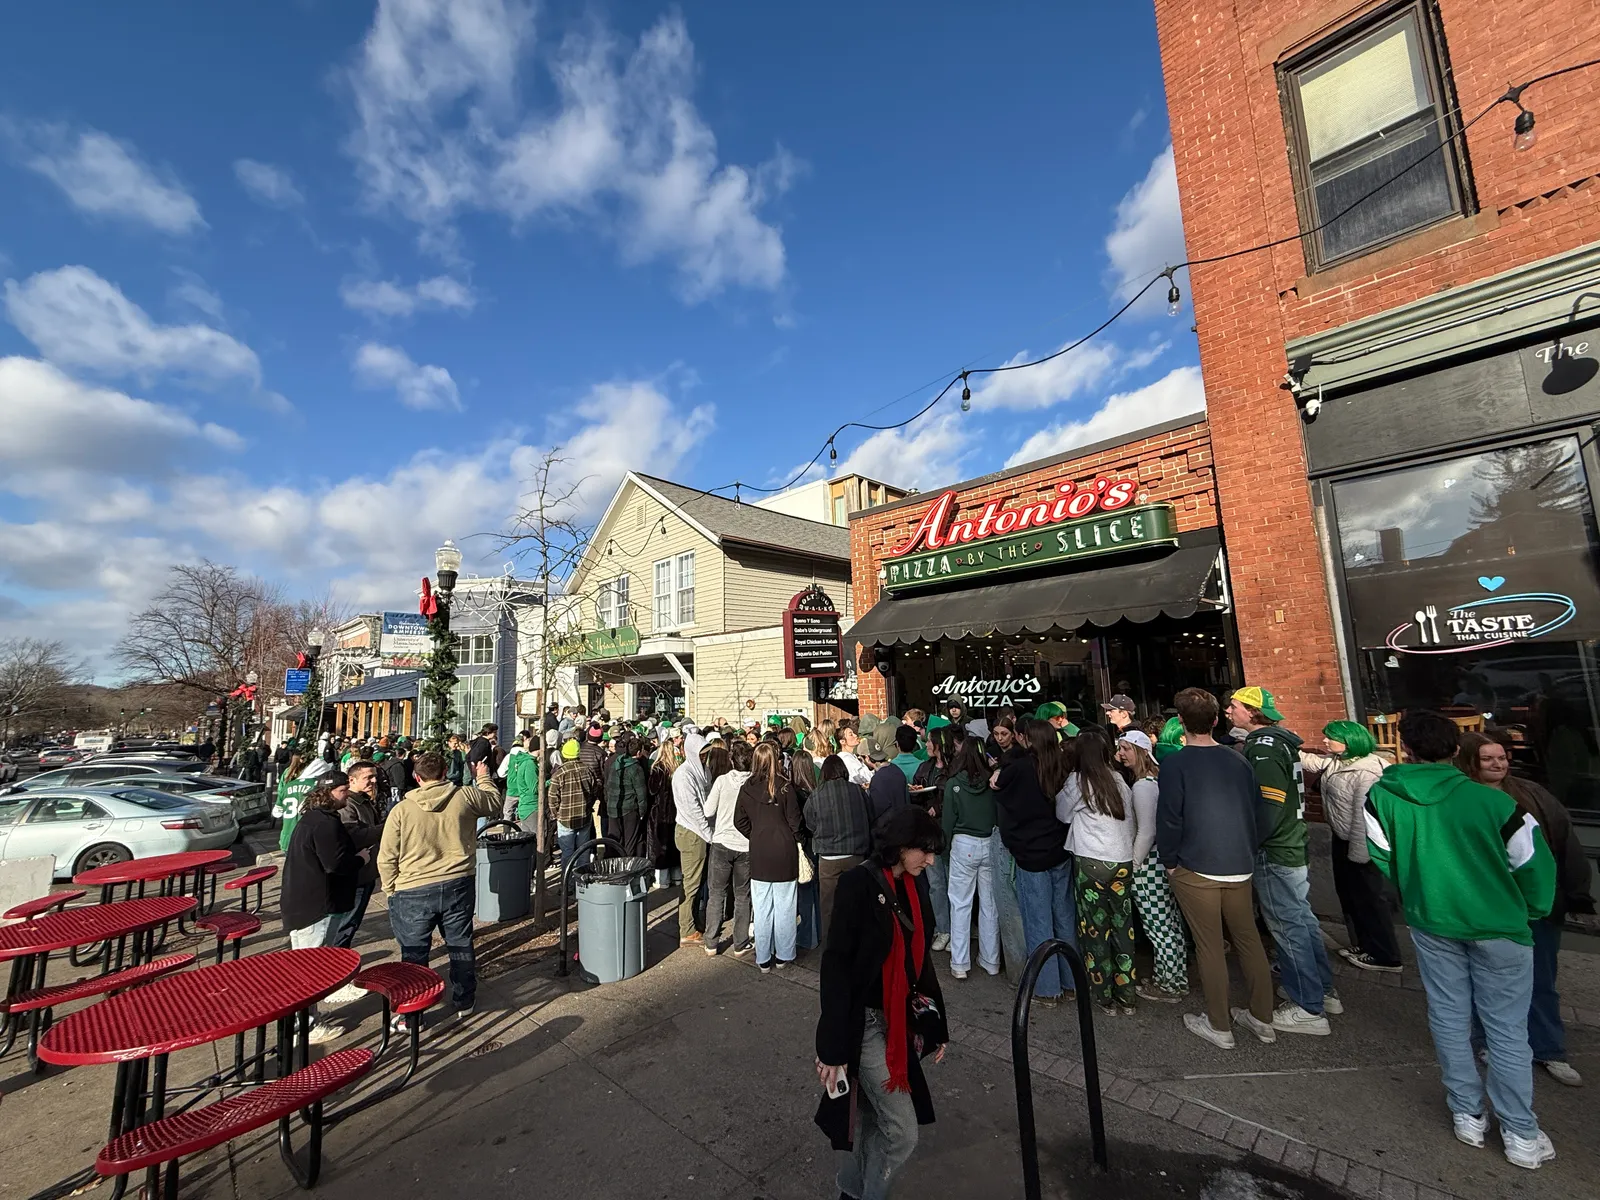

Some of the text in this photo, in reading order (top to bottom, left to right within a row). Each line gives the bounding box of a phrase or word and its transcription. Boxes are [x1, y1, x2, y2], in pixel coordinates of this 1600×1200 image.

[1535, 342, 1589, 364] The
[890, 477, 1139, 556] Antonio's
[889, 516, 1144, 582] PIZZA BY THE SLICE
[1446, 614, 1535, 633] TASTE
[1449, 609, 1476, 619] The
[1456, 631, 1528, 641] THAI CUISINE
[931, 674, 1041, 695] Antonio's
[1254, 736, 1274, 747] 12
[287, 784, 311, 795] ORTIZ
